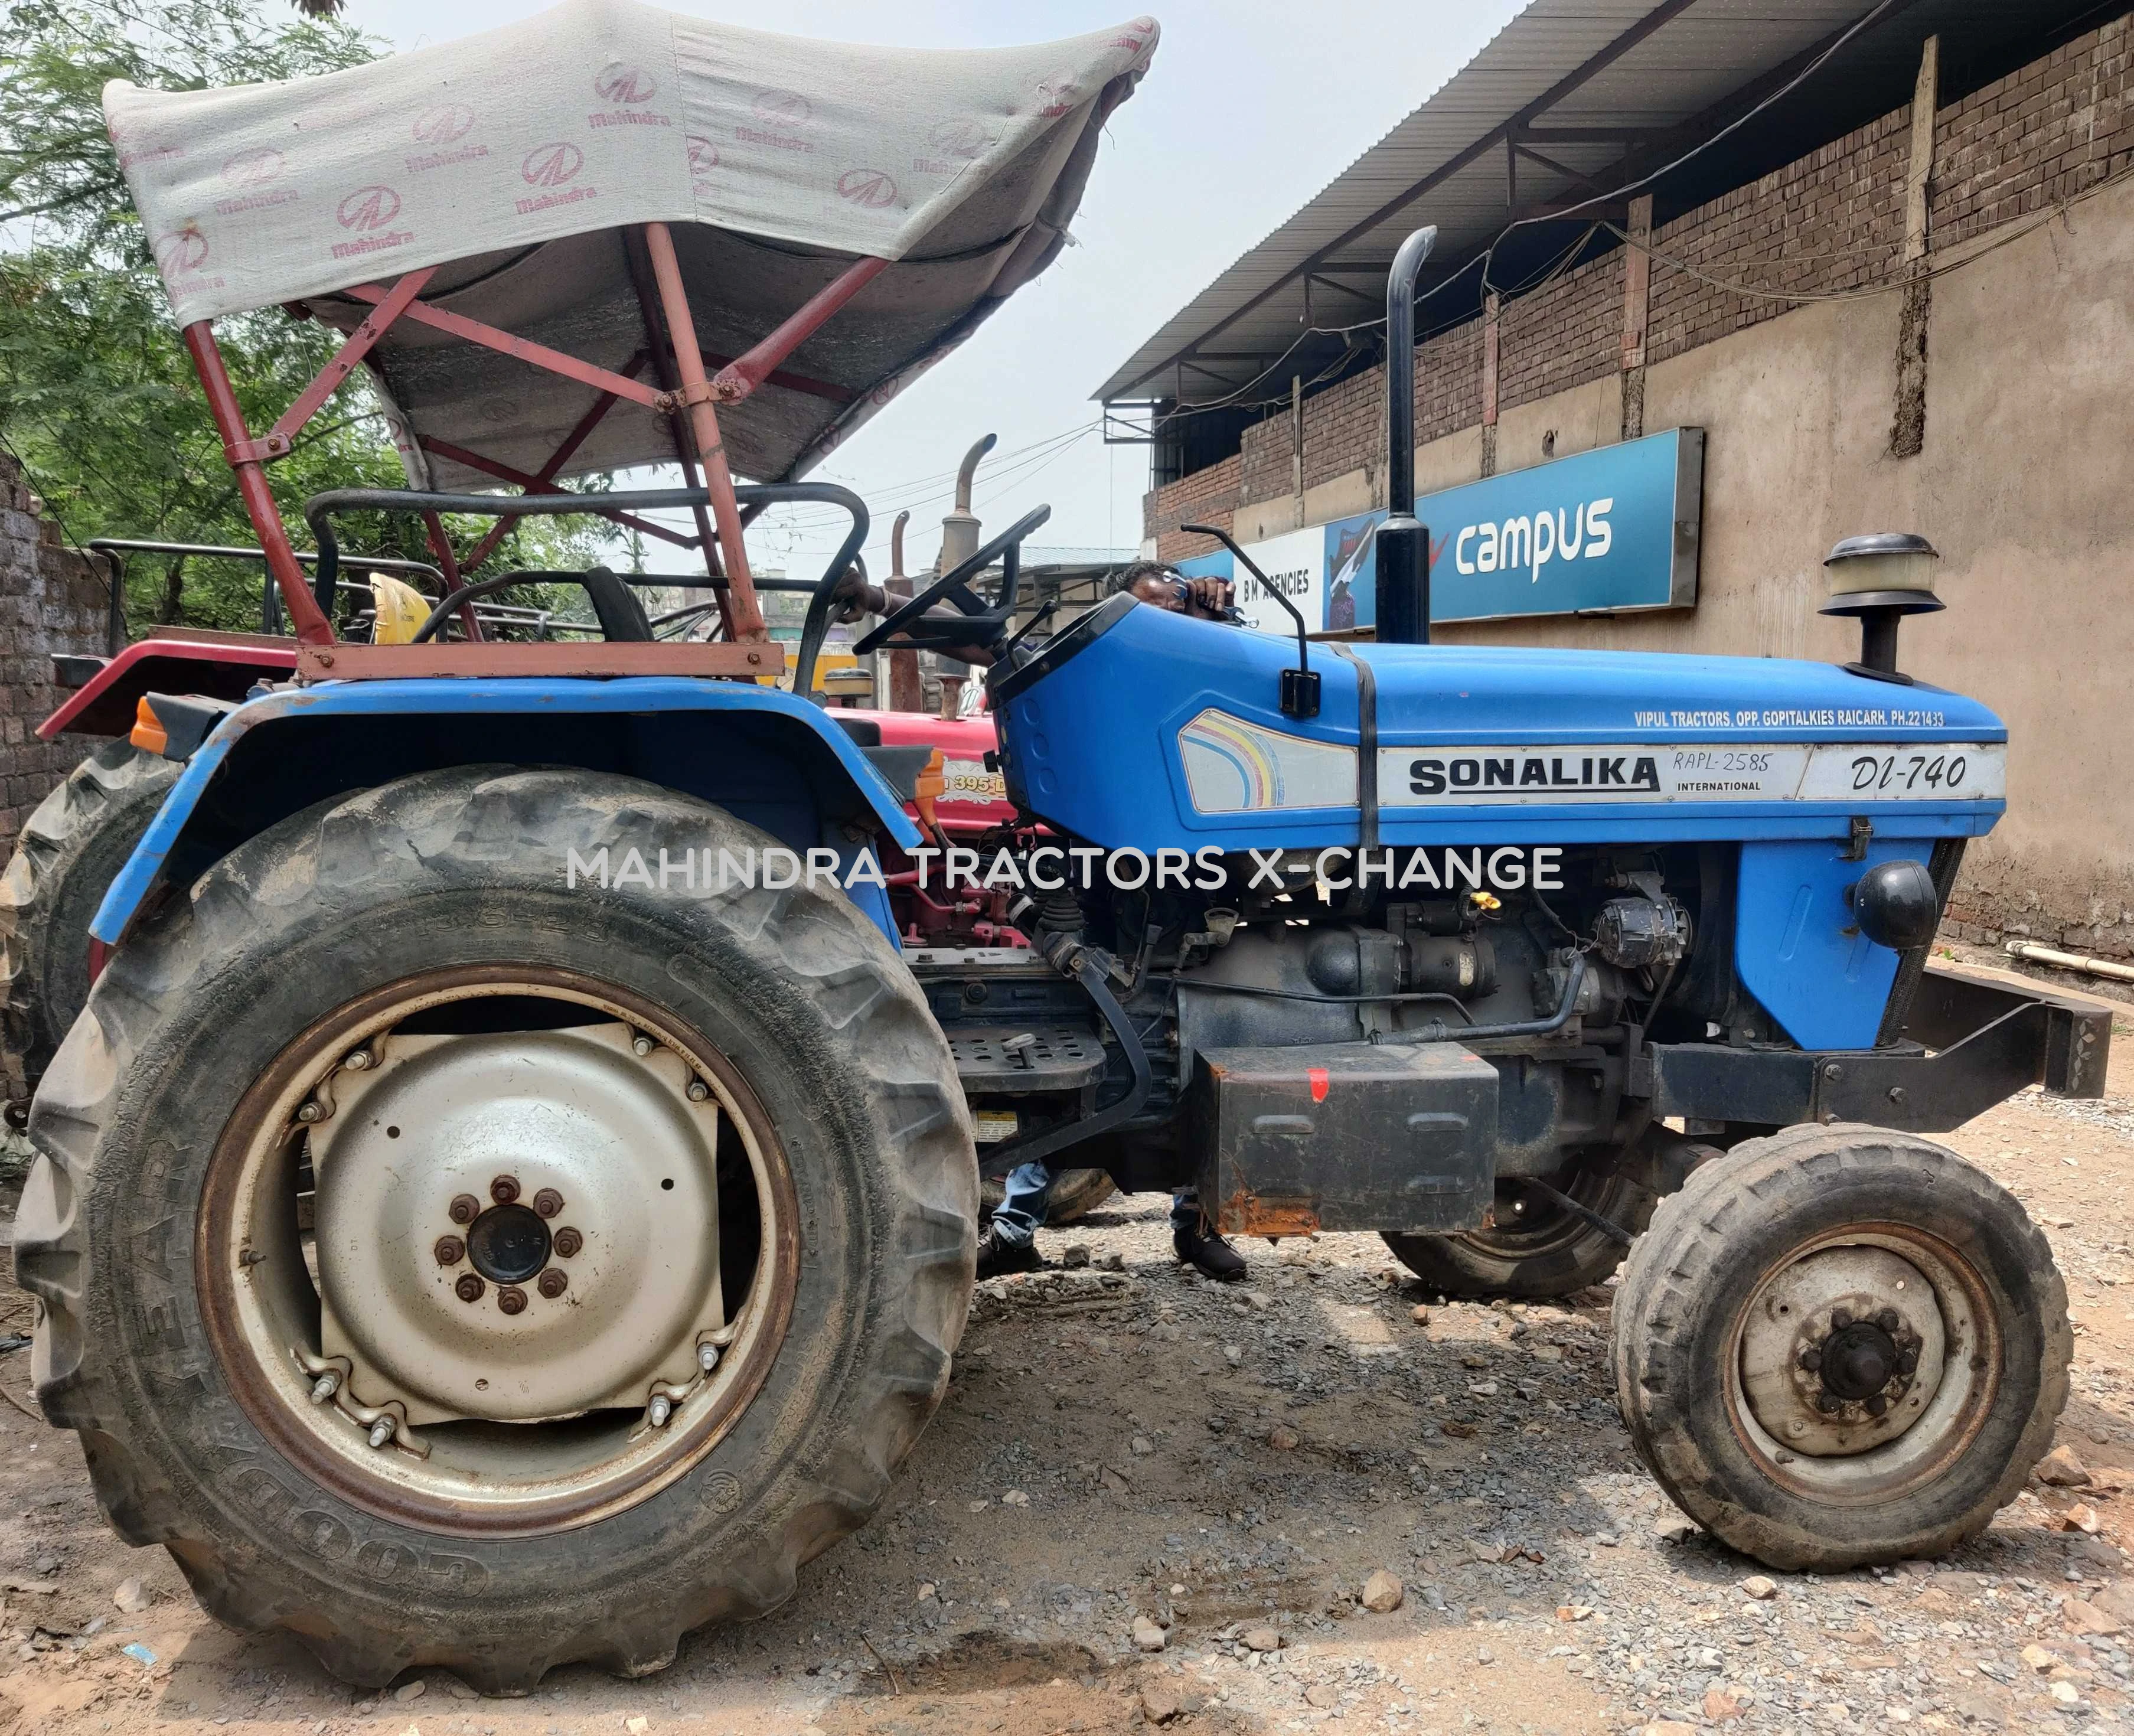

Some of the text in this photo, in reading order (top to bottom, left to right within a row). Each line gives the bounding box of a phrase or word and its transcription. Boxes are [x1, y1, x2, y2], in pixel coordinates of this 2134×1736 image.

[515, 187, 598, 216] Mahindra
[331, 231, 416, 259] Mahindra
[1455, 497, 1613, 584] campus
[1634, 712, 1669, 727] VIPUL
[954, 775, 990, 792] 395
[1409, 757, 1661, 795] SONALIKA
[1677, 782, 1761, 791] INTERNATIONAL
[130, 1137, 490, 1599] GOODYEAR
